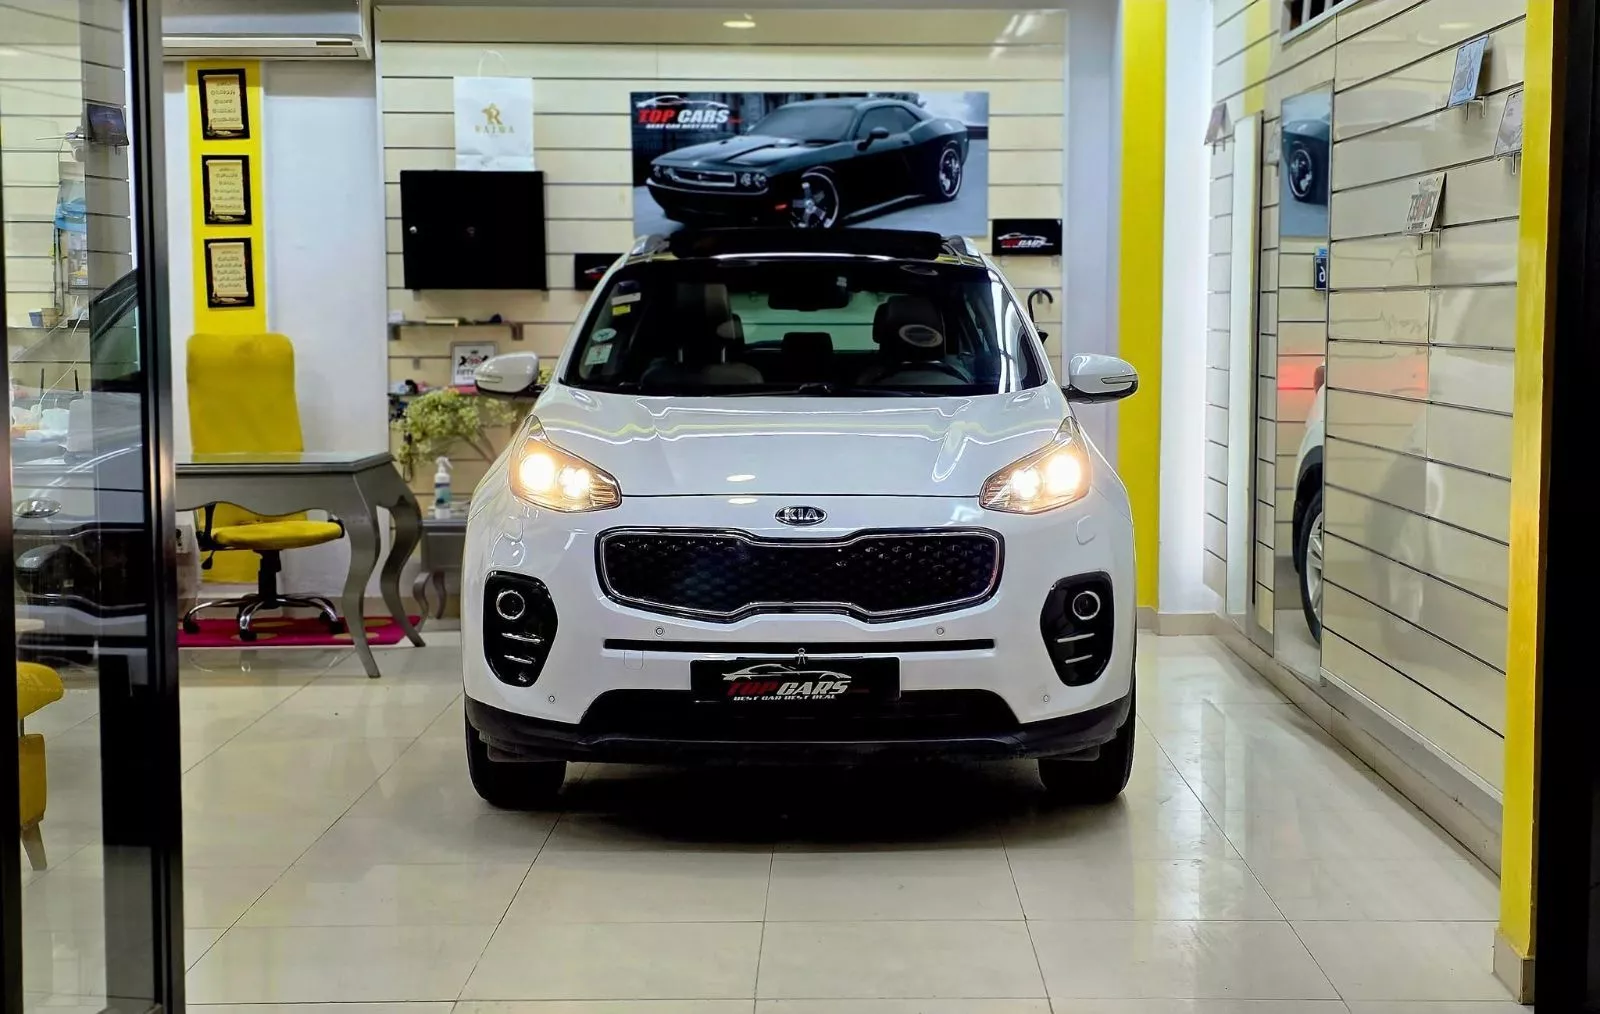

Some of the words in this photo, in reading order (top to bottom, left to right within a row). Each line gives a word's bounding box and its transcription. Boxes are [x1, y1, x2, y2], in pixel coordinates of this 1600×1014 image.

[638, 109, 675, 123] TOP
[677, 109, 730, 123] CARS
[784, 508, 818, 520] KIA
[727, 681, 778, 696] TOP
[776, 680, 852, 696] CARS
